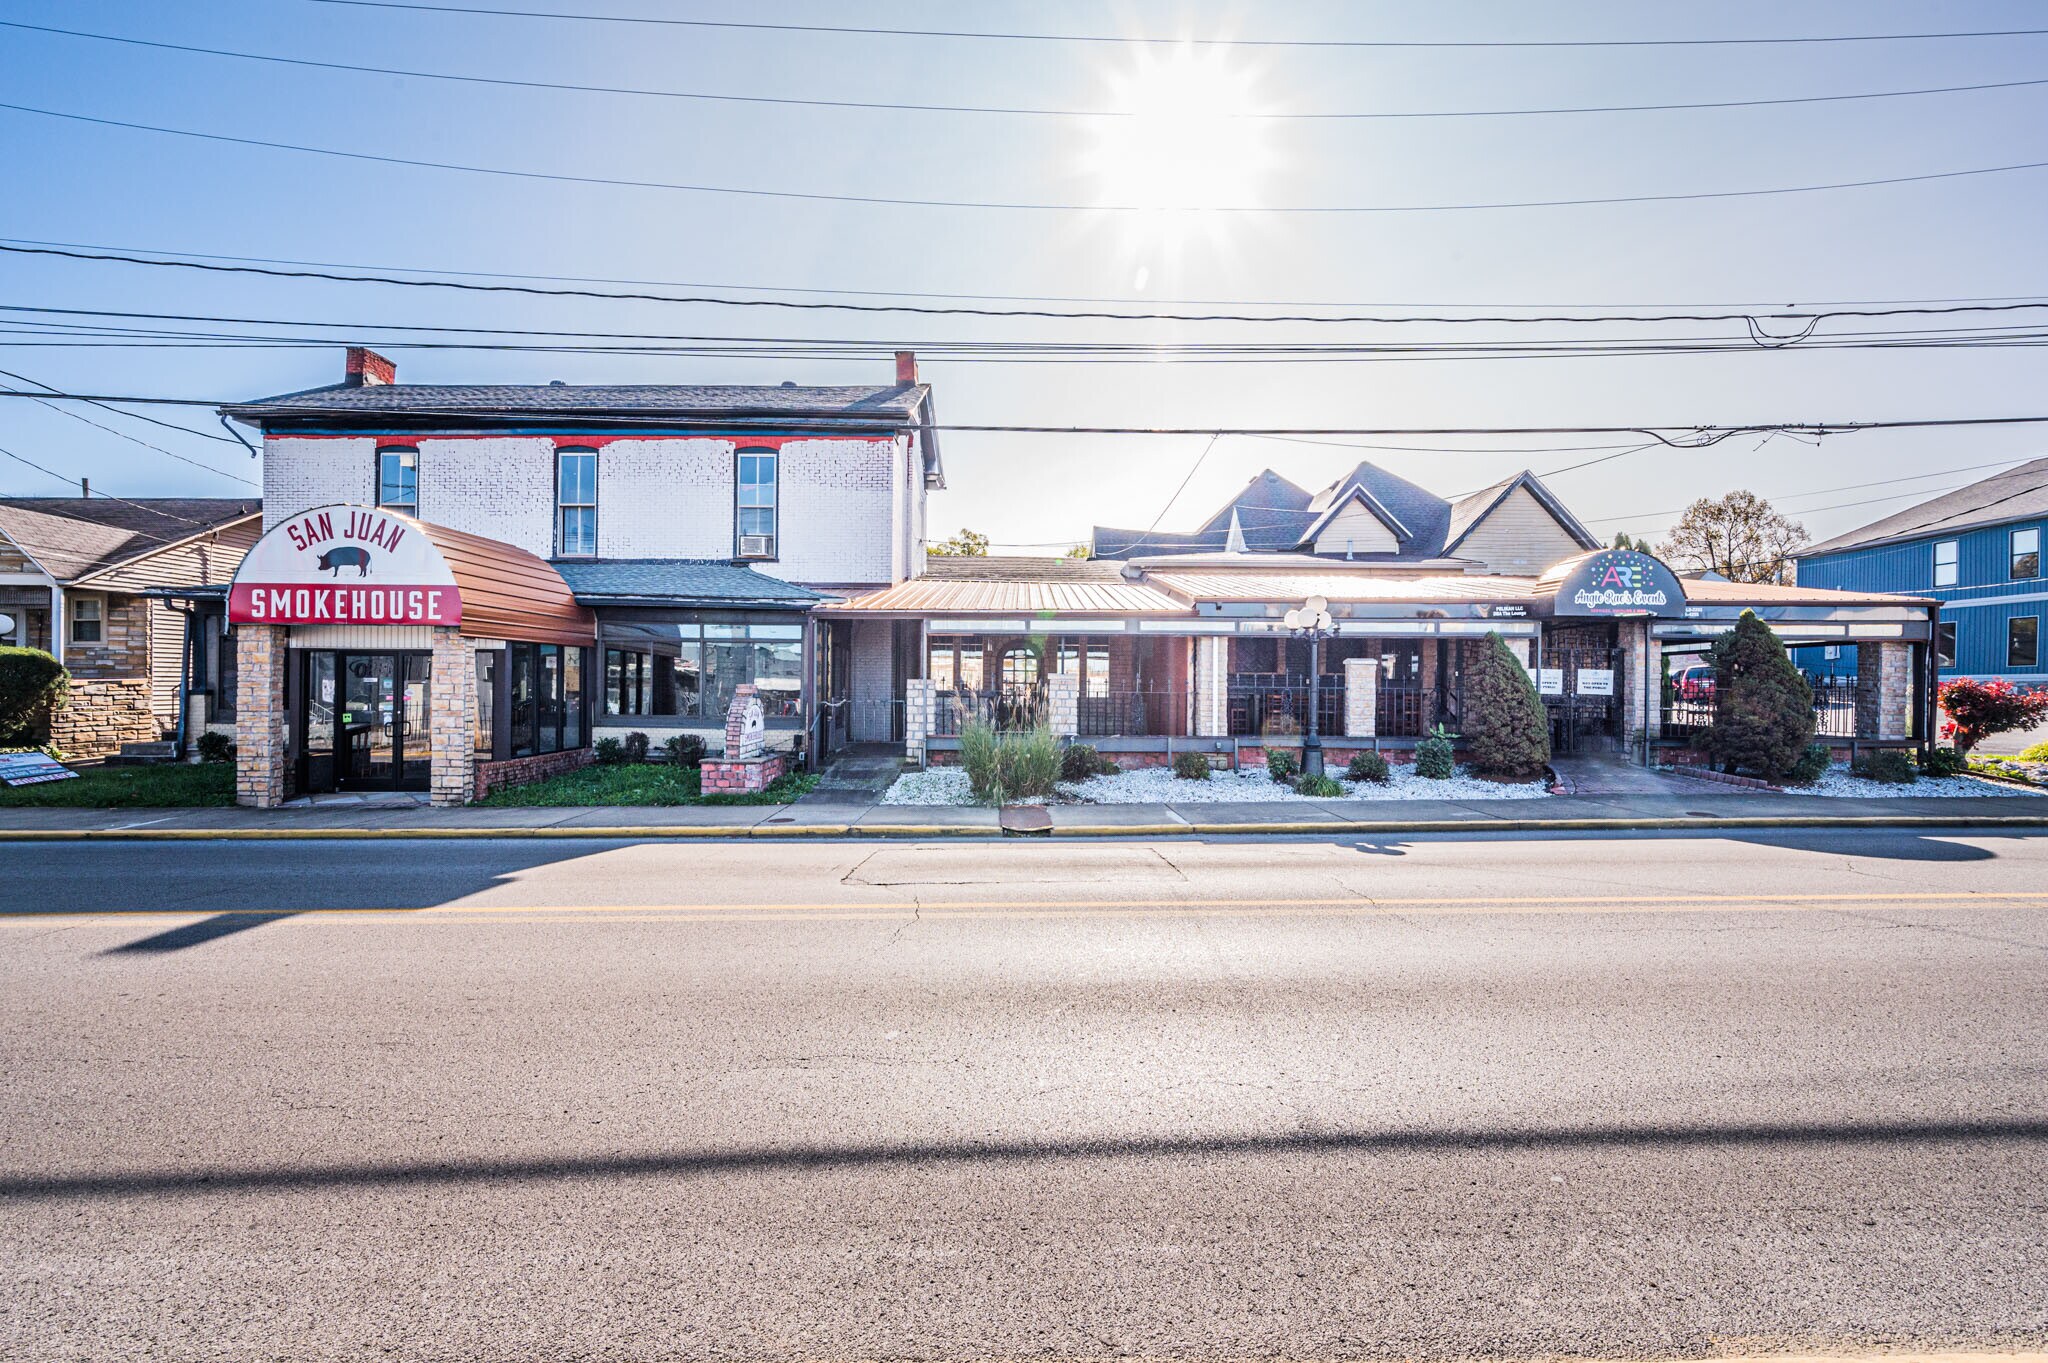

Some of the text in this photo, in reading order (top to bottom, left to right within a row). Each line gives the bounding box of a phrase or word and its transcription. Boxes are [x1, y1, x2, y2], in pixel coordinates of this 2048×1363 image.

[287, 511, 405, 554] SAN JUAN
[1601, 566, 1642, 588] ARE
[251, 589, 442, 620] SMOKEHOUSE
[1575, 589, 1666, 608] Angie Rae's Events
